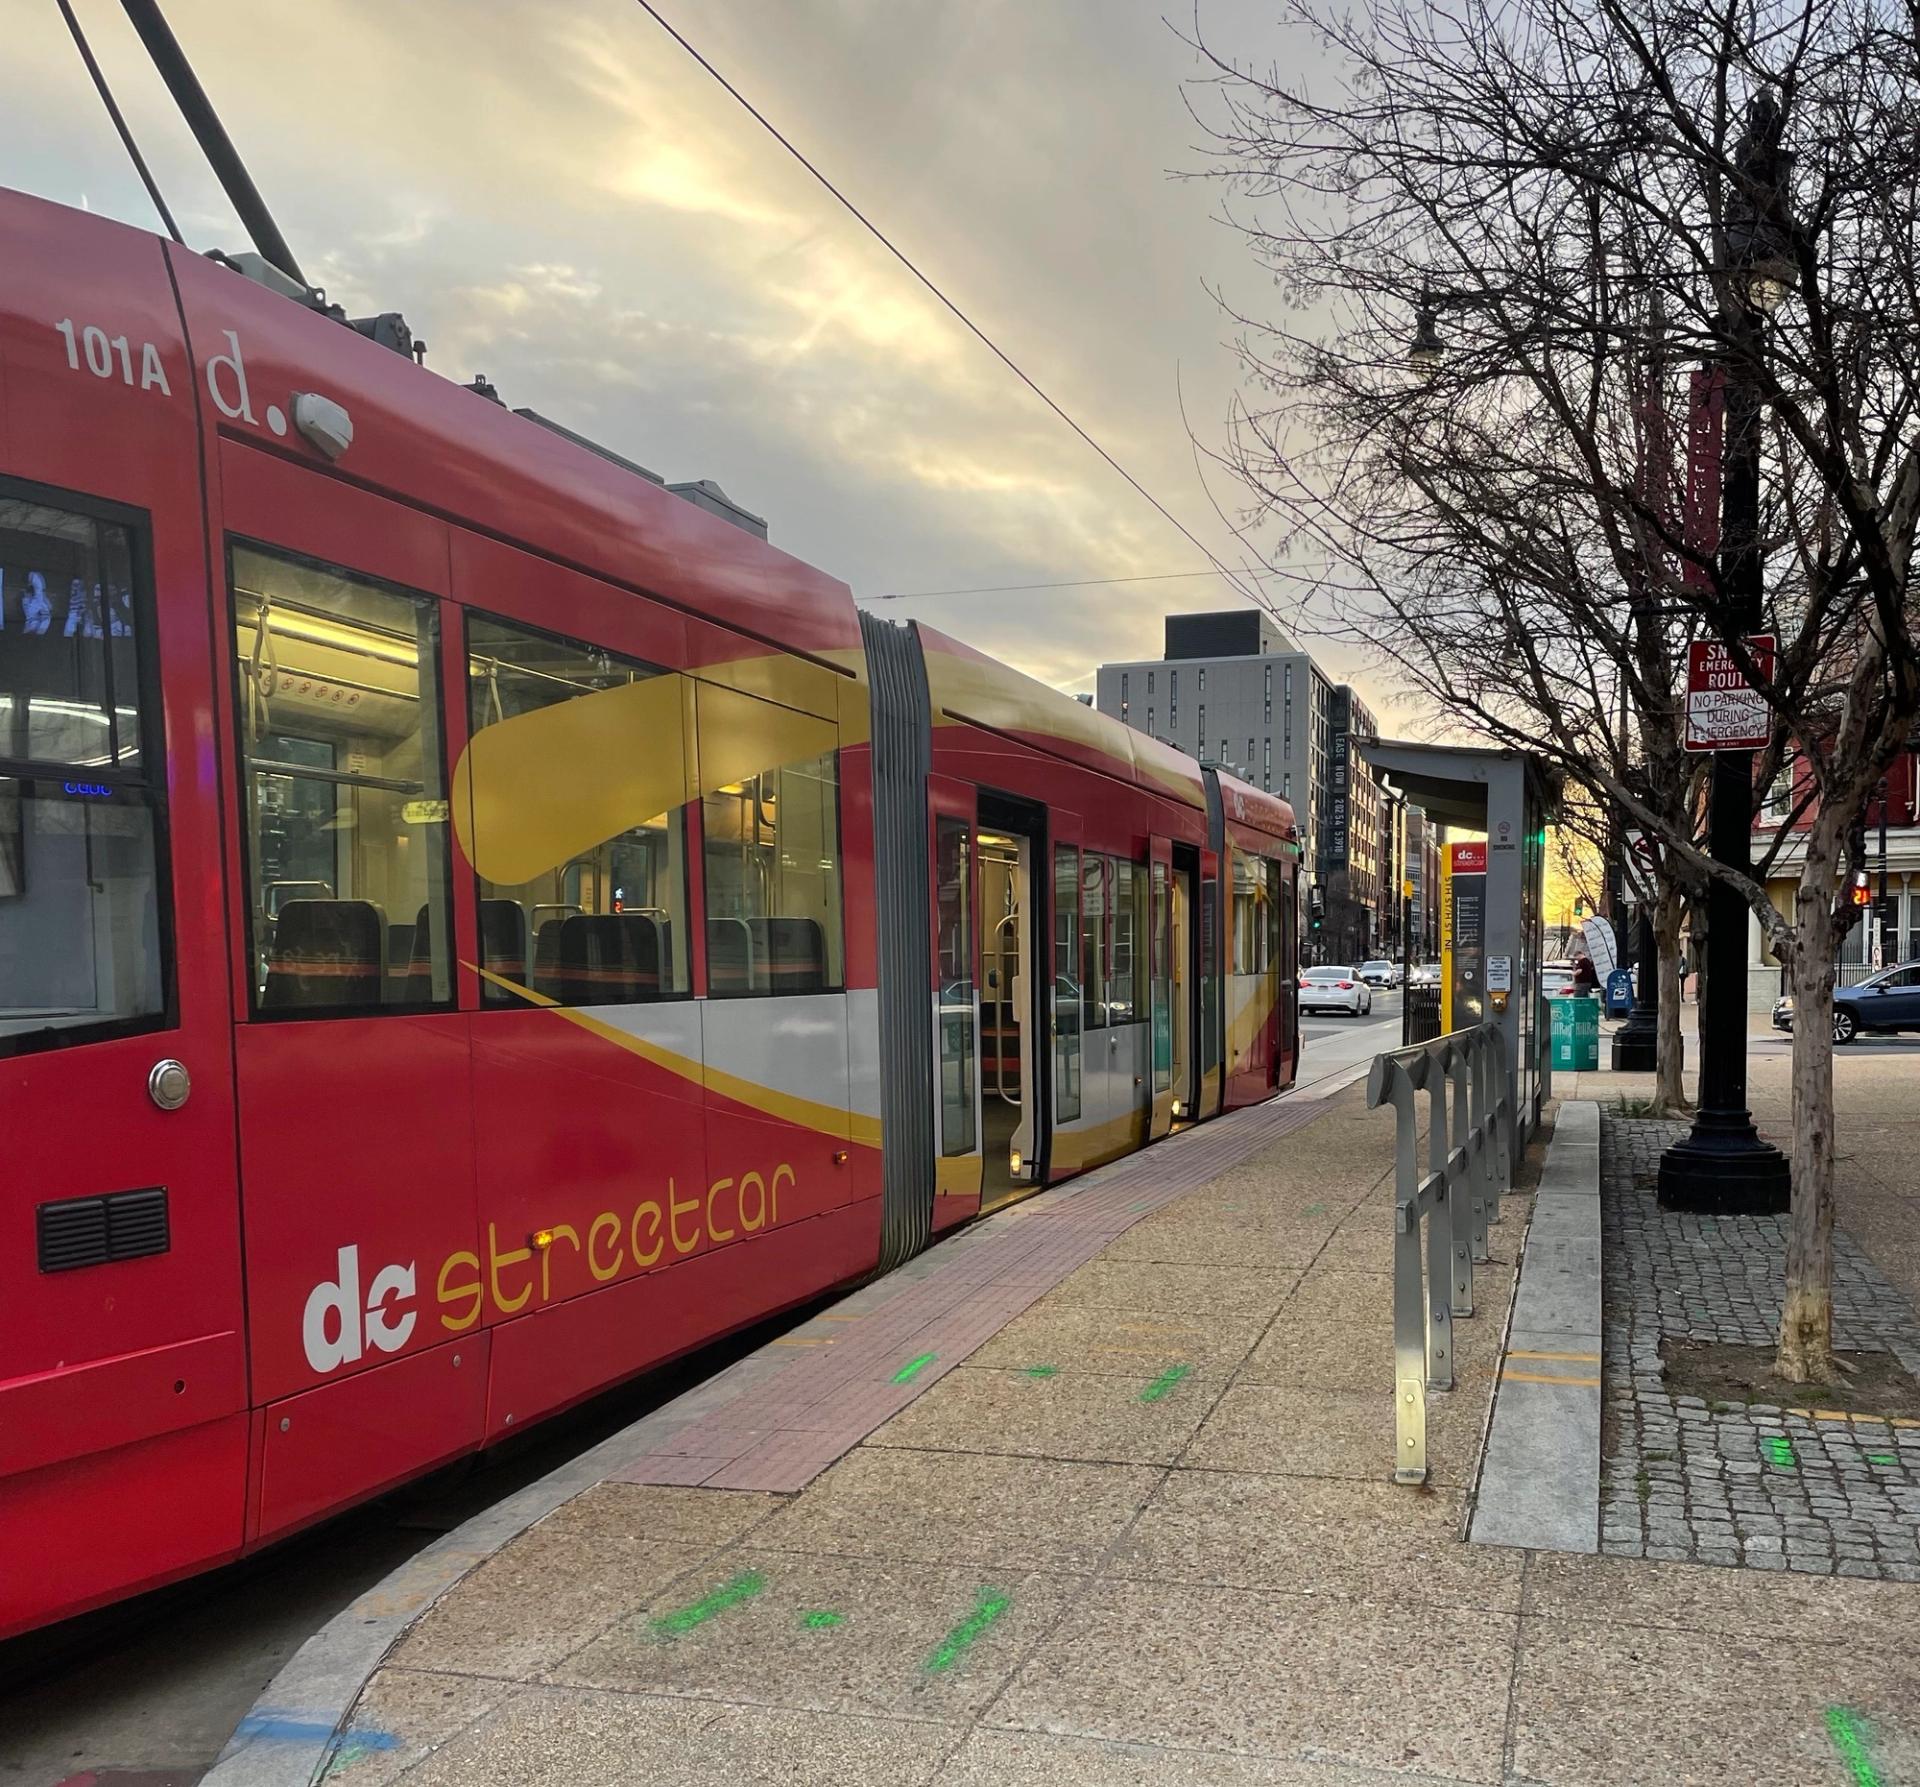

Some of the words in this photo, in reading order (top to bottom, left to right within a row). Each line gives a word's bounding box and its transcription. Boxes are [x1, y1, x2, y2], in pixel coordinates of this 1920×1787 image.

[56, 318, 171, 397] 101A
[1700, 656, 1764, 671] EMERGY
[1708, 672, 1750, 688] ROUT
[1694, 694, 1711, 708] NO
[1714, 691, 1764, 706] PARKING
[1707, 709, 1750, 723] DURING
[1693, 724, 1763, 739] EMERGENCY
[1335, 733, 1345, 758] LEASE
[1335, 765, 1345, 784] NOW
[1445, 939, 1452, 952] NE
[302, 1243, 418, 1373] dc
[437, 1163, 796, 1331] streetcar
